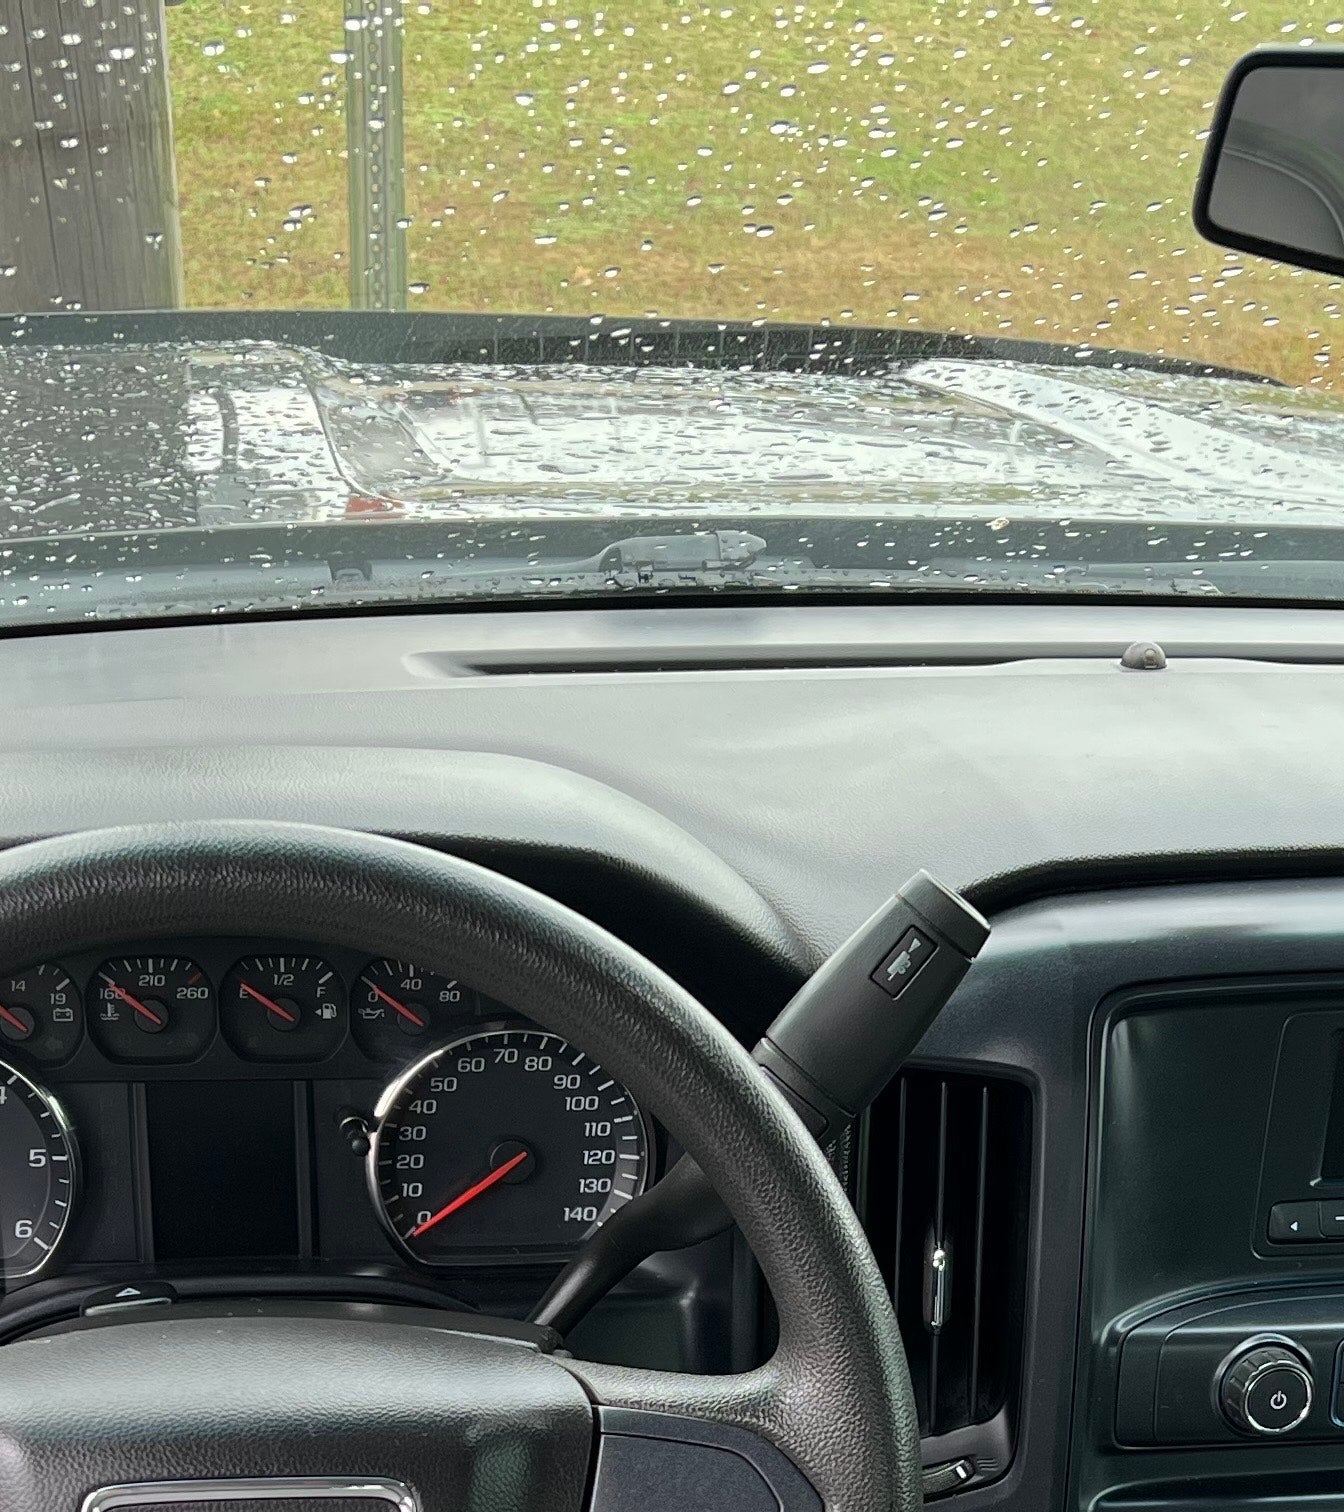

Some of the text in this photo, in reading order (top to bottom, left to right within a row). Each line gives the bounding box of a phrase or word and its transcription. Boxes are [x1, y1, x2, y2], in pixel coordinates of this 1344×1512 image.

[10, 980, 26, 992] 14
[138, 974, 166, 987] 210
[273, 973, 295, 986] 1/2
[400, 978, 422, 991] 40
[50, 993, 67, 1005] 19
[176, 987, 209, 999] 260
[317, 986, 327, 998] F
[439, 990, 461, 1002] 80
[493, 1048, 518, 1063] 70
[457, 1057, 485, 1073] 60
[524, 1056, 552, 1072] 80
[430, 1077, 458, 1092] 50
[553, 1074, 581, 1090] 90
[408, 1099, 437, 1115] 40
[564, 1096, 599, 1112] 100
[399, 1126, 427, 1142] 30
[584, 1121, 611, 1137] 110
[28, 1148, 47, 1168] 5
[396, 1154, 424, 1169] 20
[582, 1150, 615, 1165] 120
[401, 1182, 423, 1198] 10
[578, 1178, 612, 1194] 130
[563, 1206, 598, 1222] 140
[14, 1219, 33, 1239] 6
